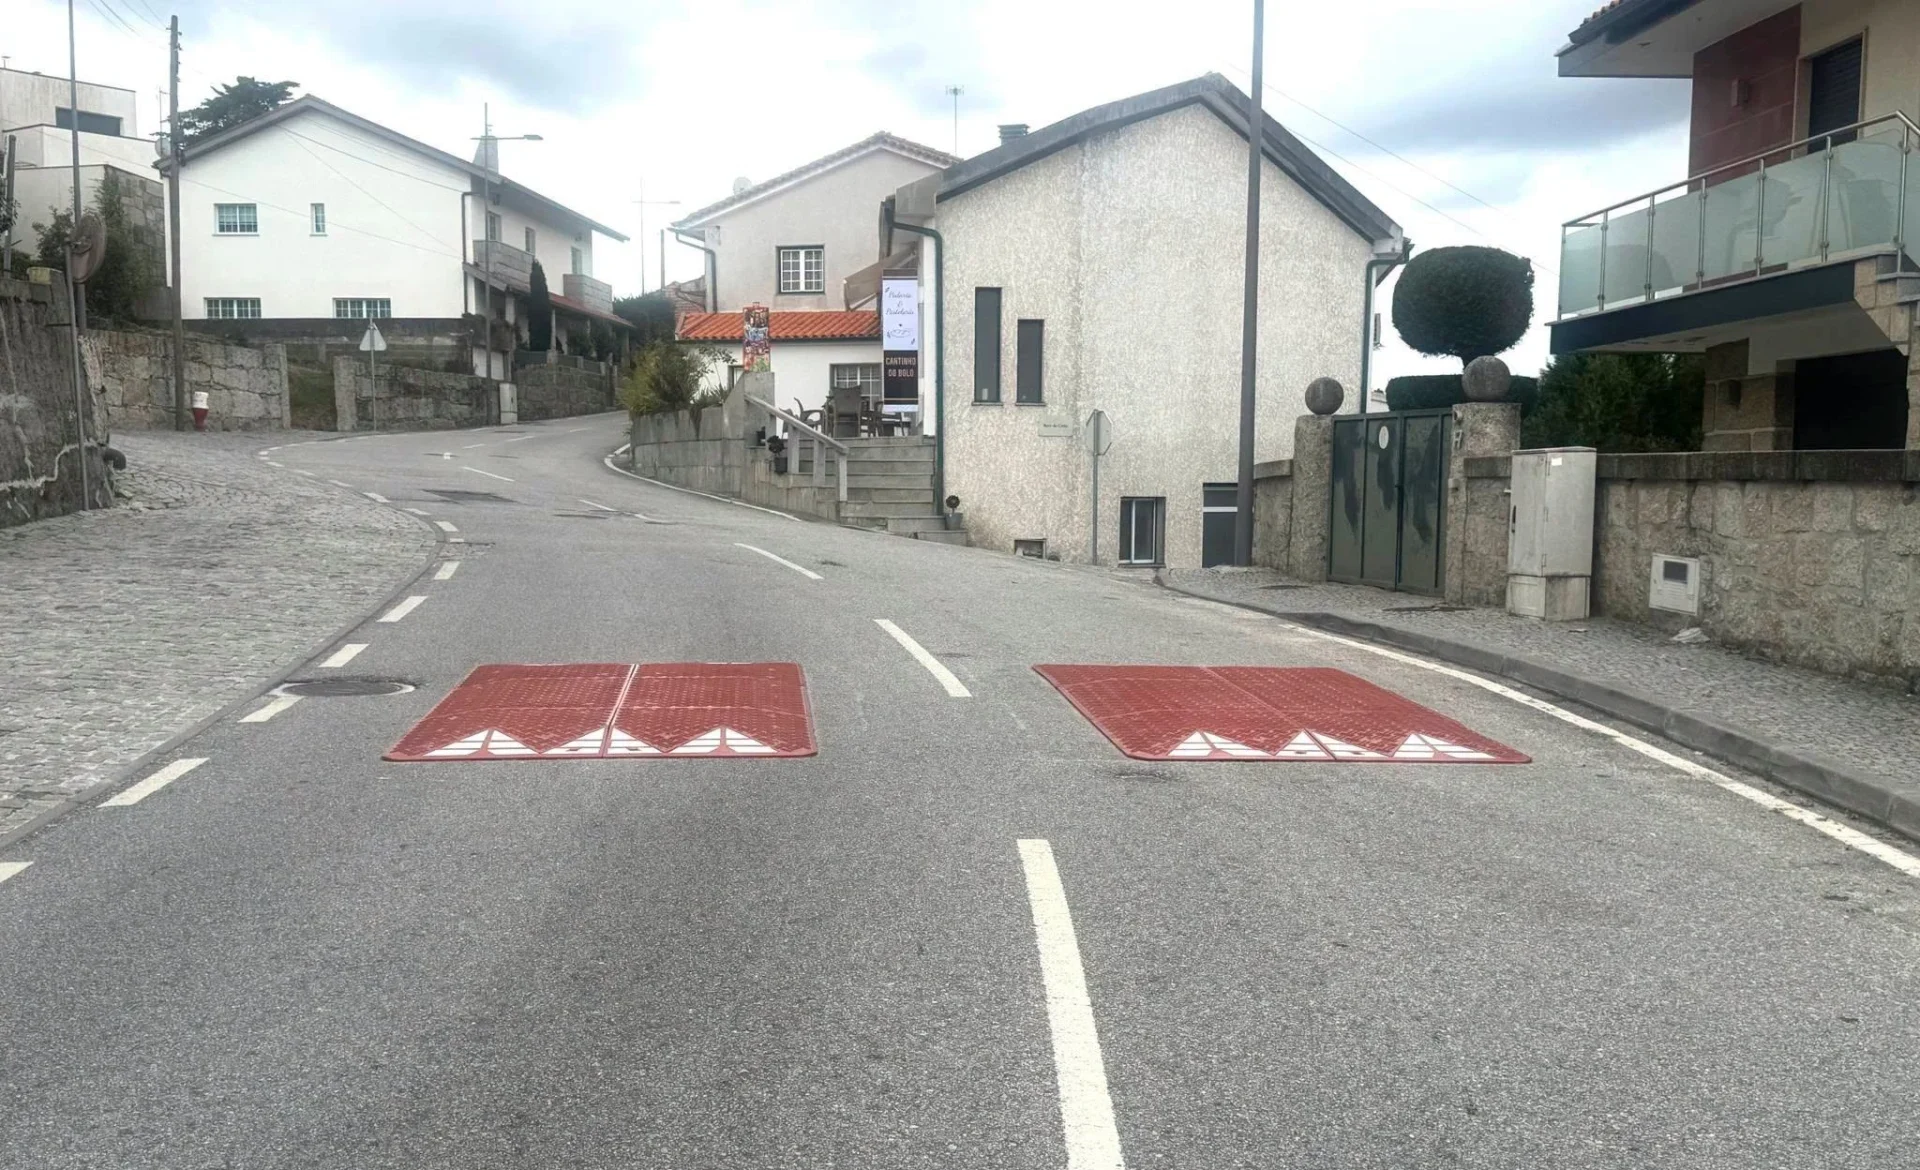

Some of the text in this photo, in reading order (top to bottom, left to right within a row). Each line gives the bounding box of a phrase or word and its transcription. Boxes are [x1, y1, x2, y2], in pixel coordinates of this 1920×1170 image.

[885, 357, 916, 365] CANTINHO
[888, 369, 914, 377] DO BOLO
